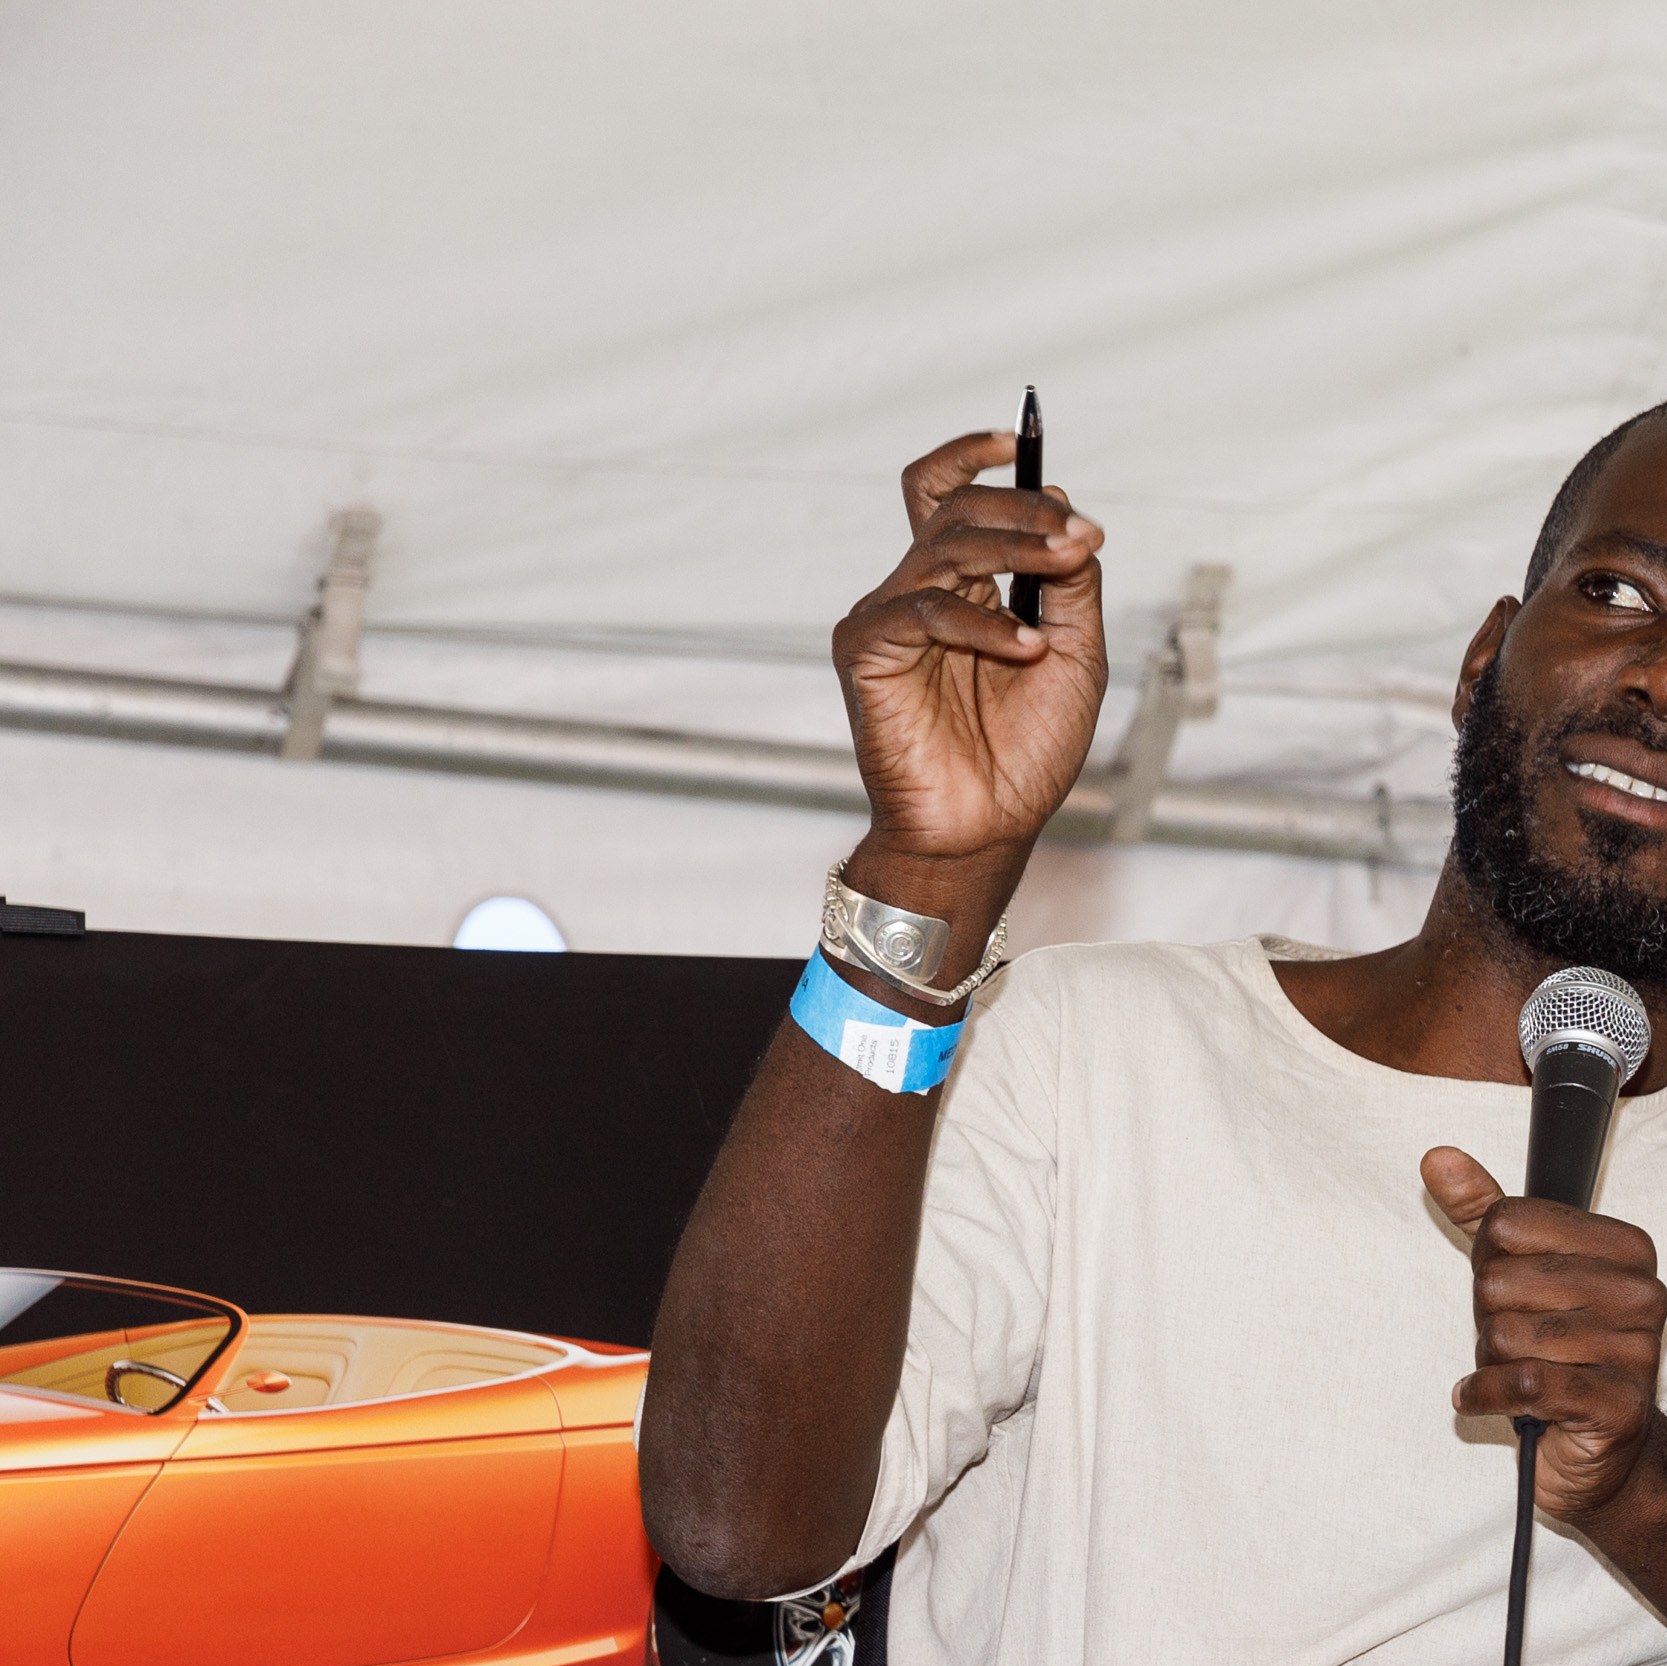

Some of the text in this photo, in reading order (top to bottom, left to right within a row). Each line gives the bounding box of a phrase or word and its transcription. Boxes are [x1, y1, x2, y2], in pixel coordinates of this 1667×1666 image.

[864, 1040, 878, 1077] Products
[885, 1039, 899, 1074] 10815
[1546, 1043, 1569, 1055] SM58
[1577, 1043, 1617, 1069] SHURE
